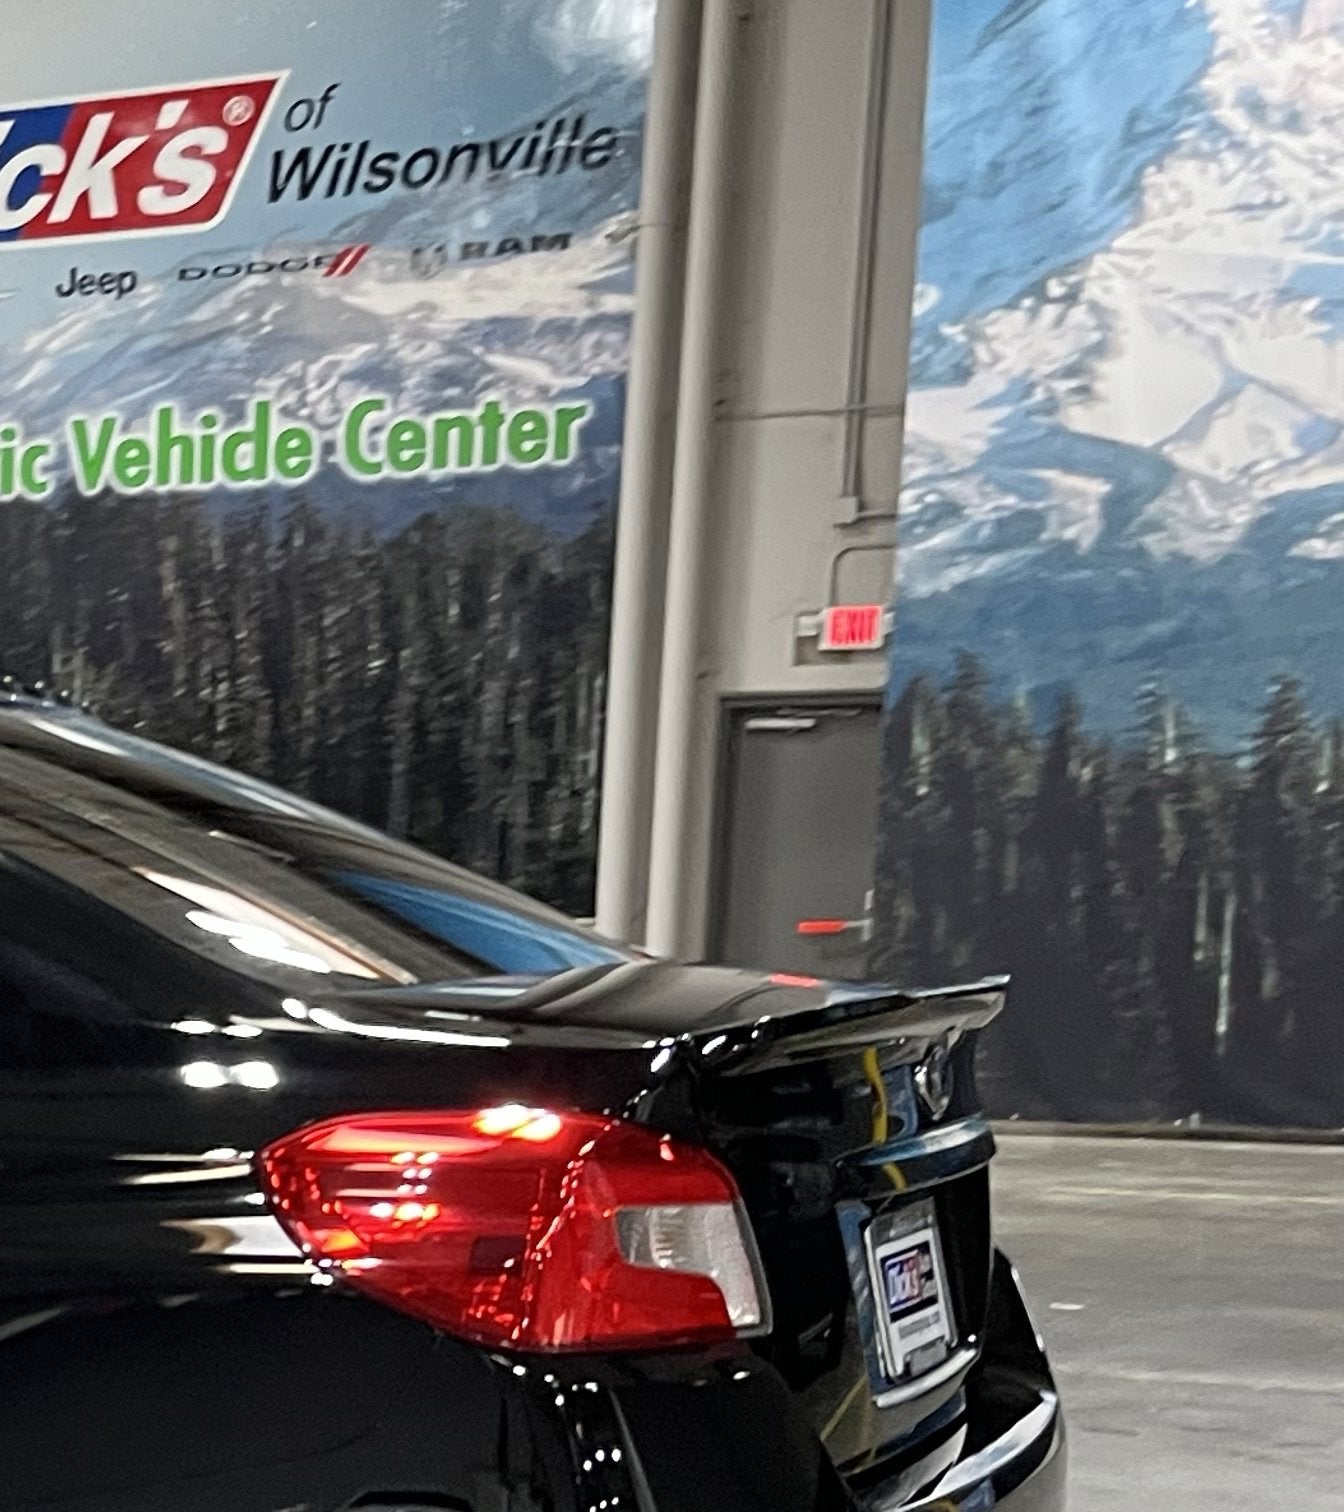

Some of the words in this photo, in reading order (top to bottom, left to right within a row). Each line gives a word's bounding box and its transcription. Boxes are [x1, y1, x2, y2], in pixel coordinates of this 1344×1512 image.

[284, 82, 341, 132] of
[267, 113, 617, 203] Wilsonville
[55, 267, 137, 300] Jeep
[345, 399, 585, 476] Center
[830, 608, 878, 644] EXIT
